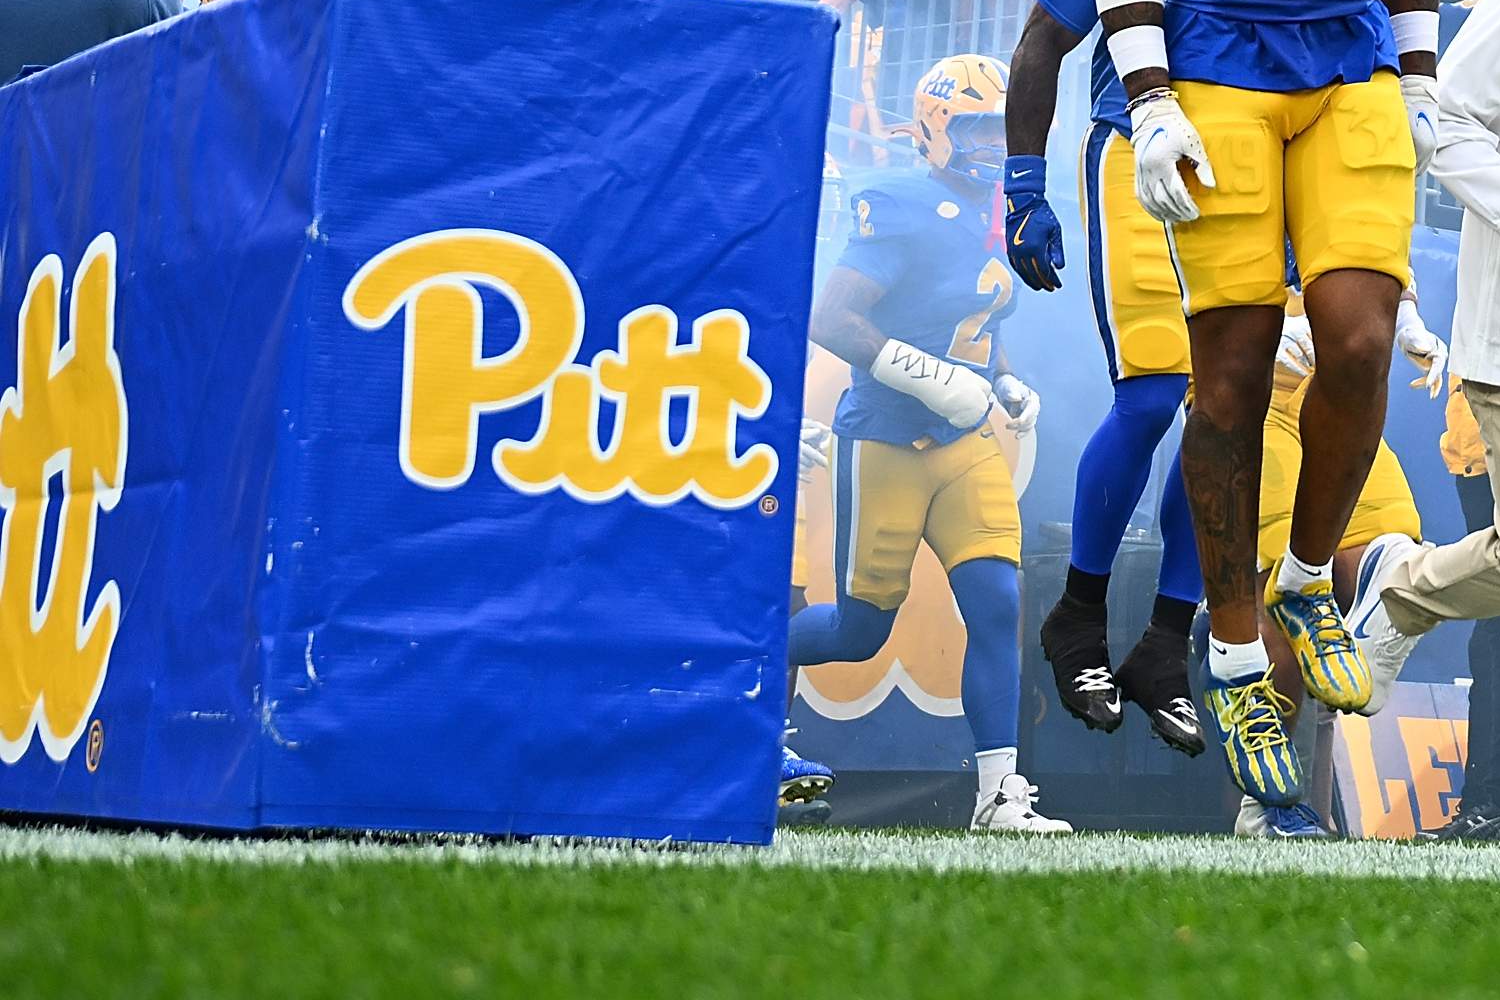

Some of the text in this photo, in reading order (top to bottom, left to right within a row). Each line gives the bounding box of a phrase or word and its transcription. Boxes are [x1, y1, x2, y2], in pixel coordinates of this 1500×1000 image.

[922, 69, 957, 101] Pitt
[857, 199, 875, 238] 2
[946, 256, 1014, 368] 2
[342, 227, 780, 511] Pitt
[1337, 708, 1469, 842] LE
